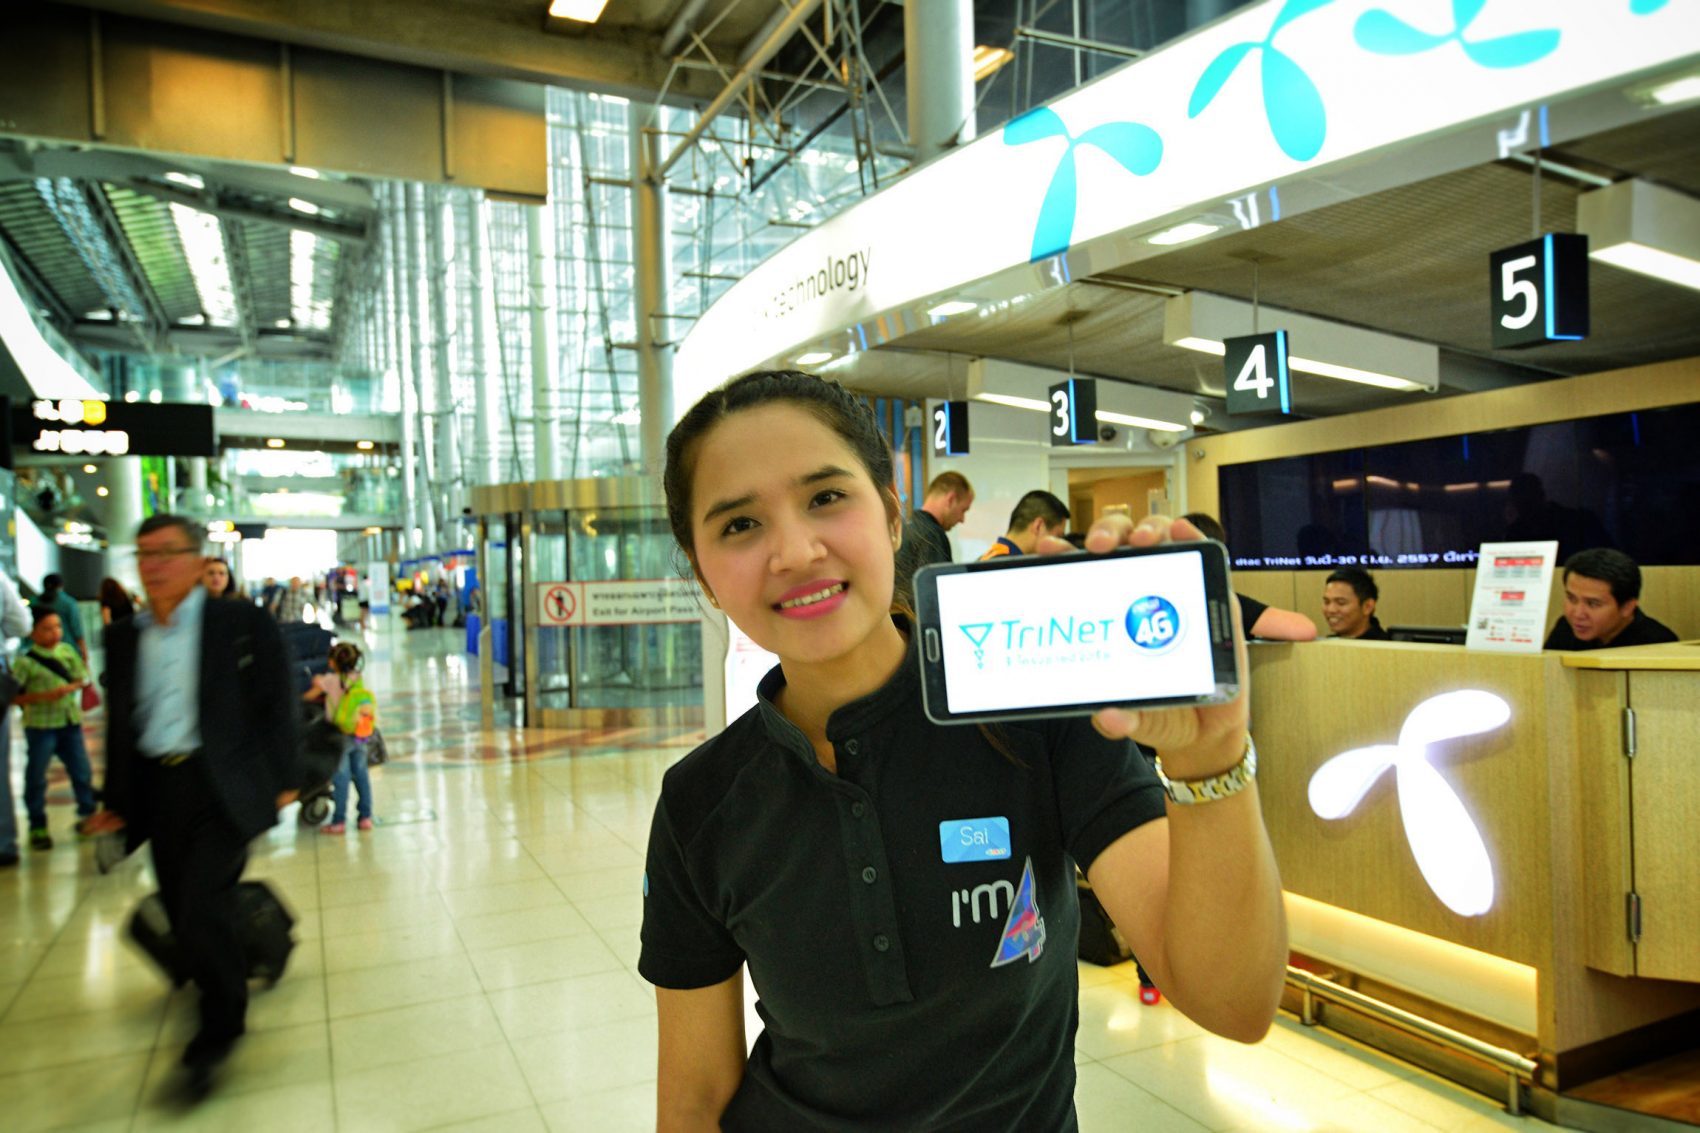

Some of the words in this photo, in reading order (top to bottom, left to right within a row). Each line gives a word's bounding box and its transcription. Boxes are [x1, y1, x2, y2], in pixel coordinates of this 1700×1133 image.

[1500, 254, 1539, 330] 5
[1233, 344, 1275, 399] 4
[934, 410, 947, 450] 2
[1051, 390, 1069, 436] 3
[1397, 553, 1440, 564] 2557
[951, 879, 1015, 928] I'm
